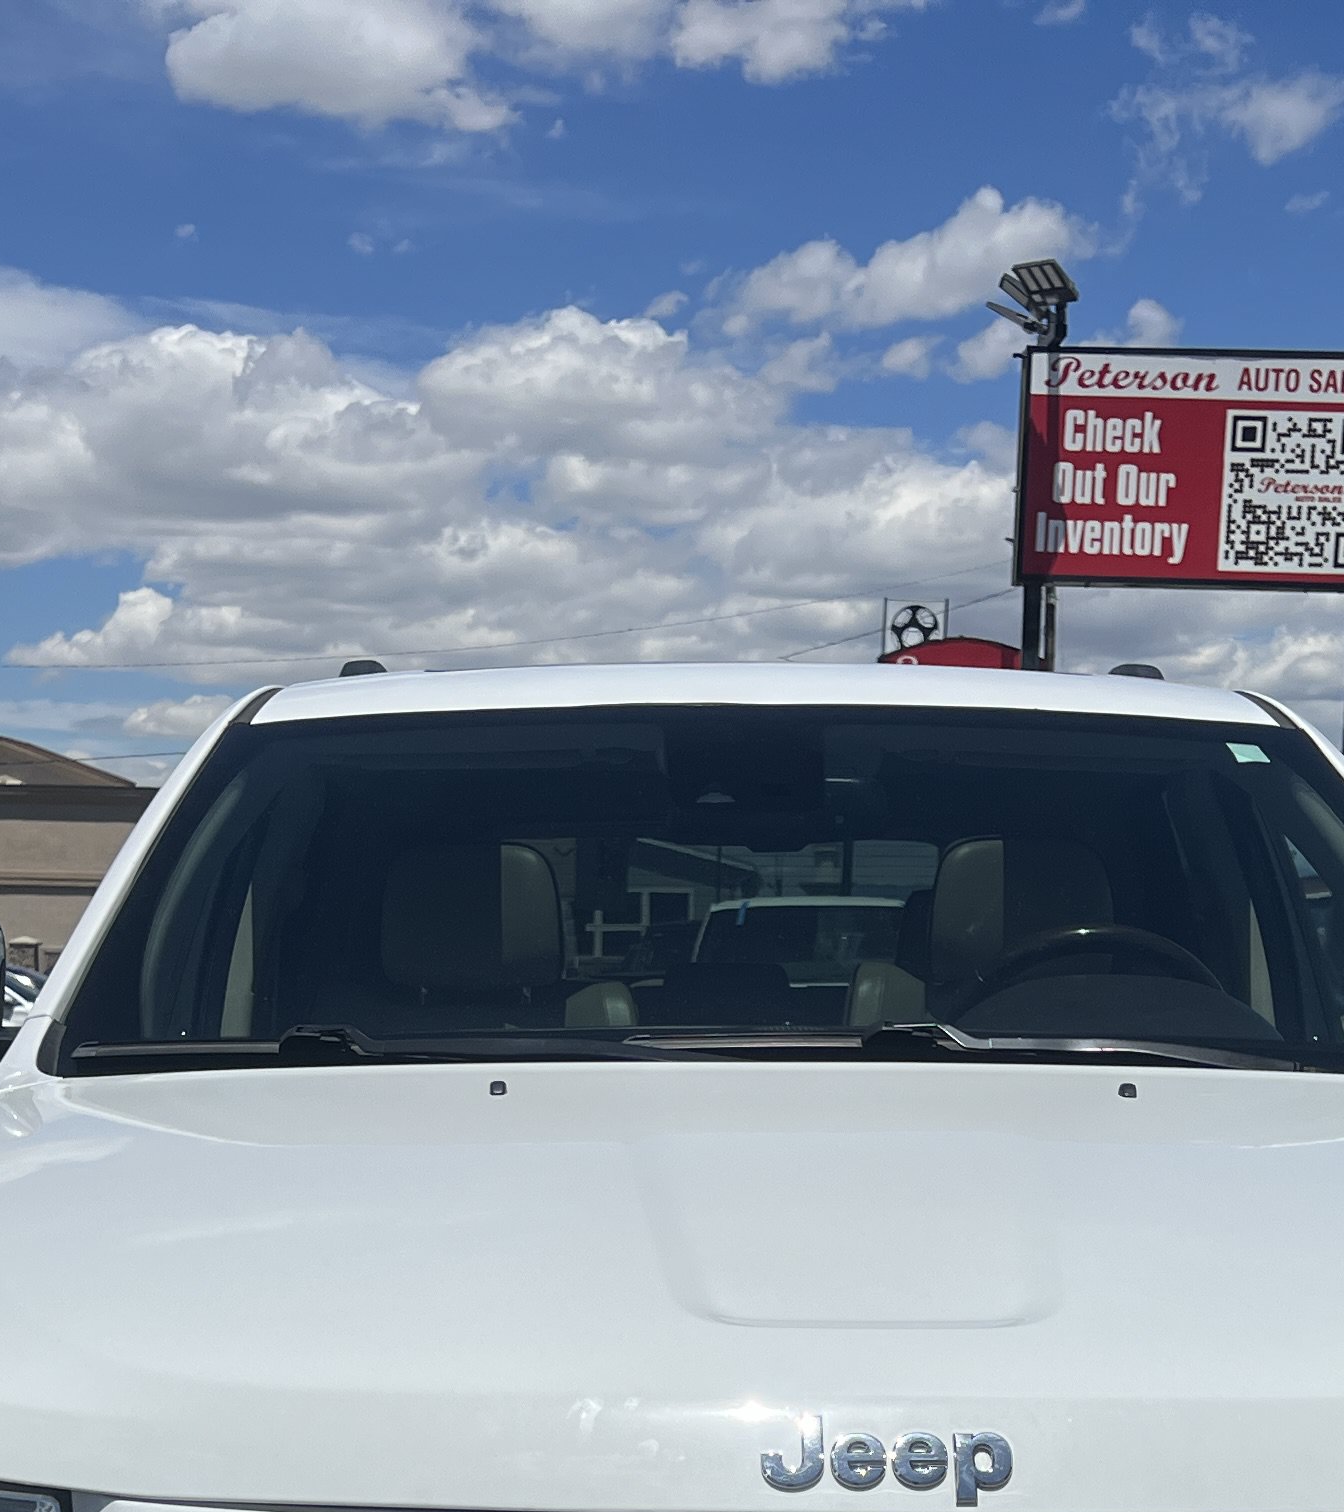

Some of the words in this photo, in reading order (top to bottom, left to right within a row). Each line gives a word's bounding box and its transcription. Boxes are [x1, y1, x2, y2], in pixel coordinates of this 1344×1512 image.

[1045, 355, 1219, 392] Peterson
[1238, 367, 1301, 393] AUTO
[1063, 408, 1162, 454] Check
[1052, 461, 1107, 505] Out
[1116, 463, 1177, 507] Our
[1257, 476, 1344, 495] Peterson
[1034, 511, 1190, 565] Inventory
[760, 1414, 1014, 1508] Jeep
